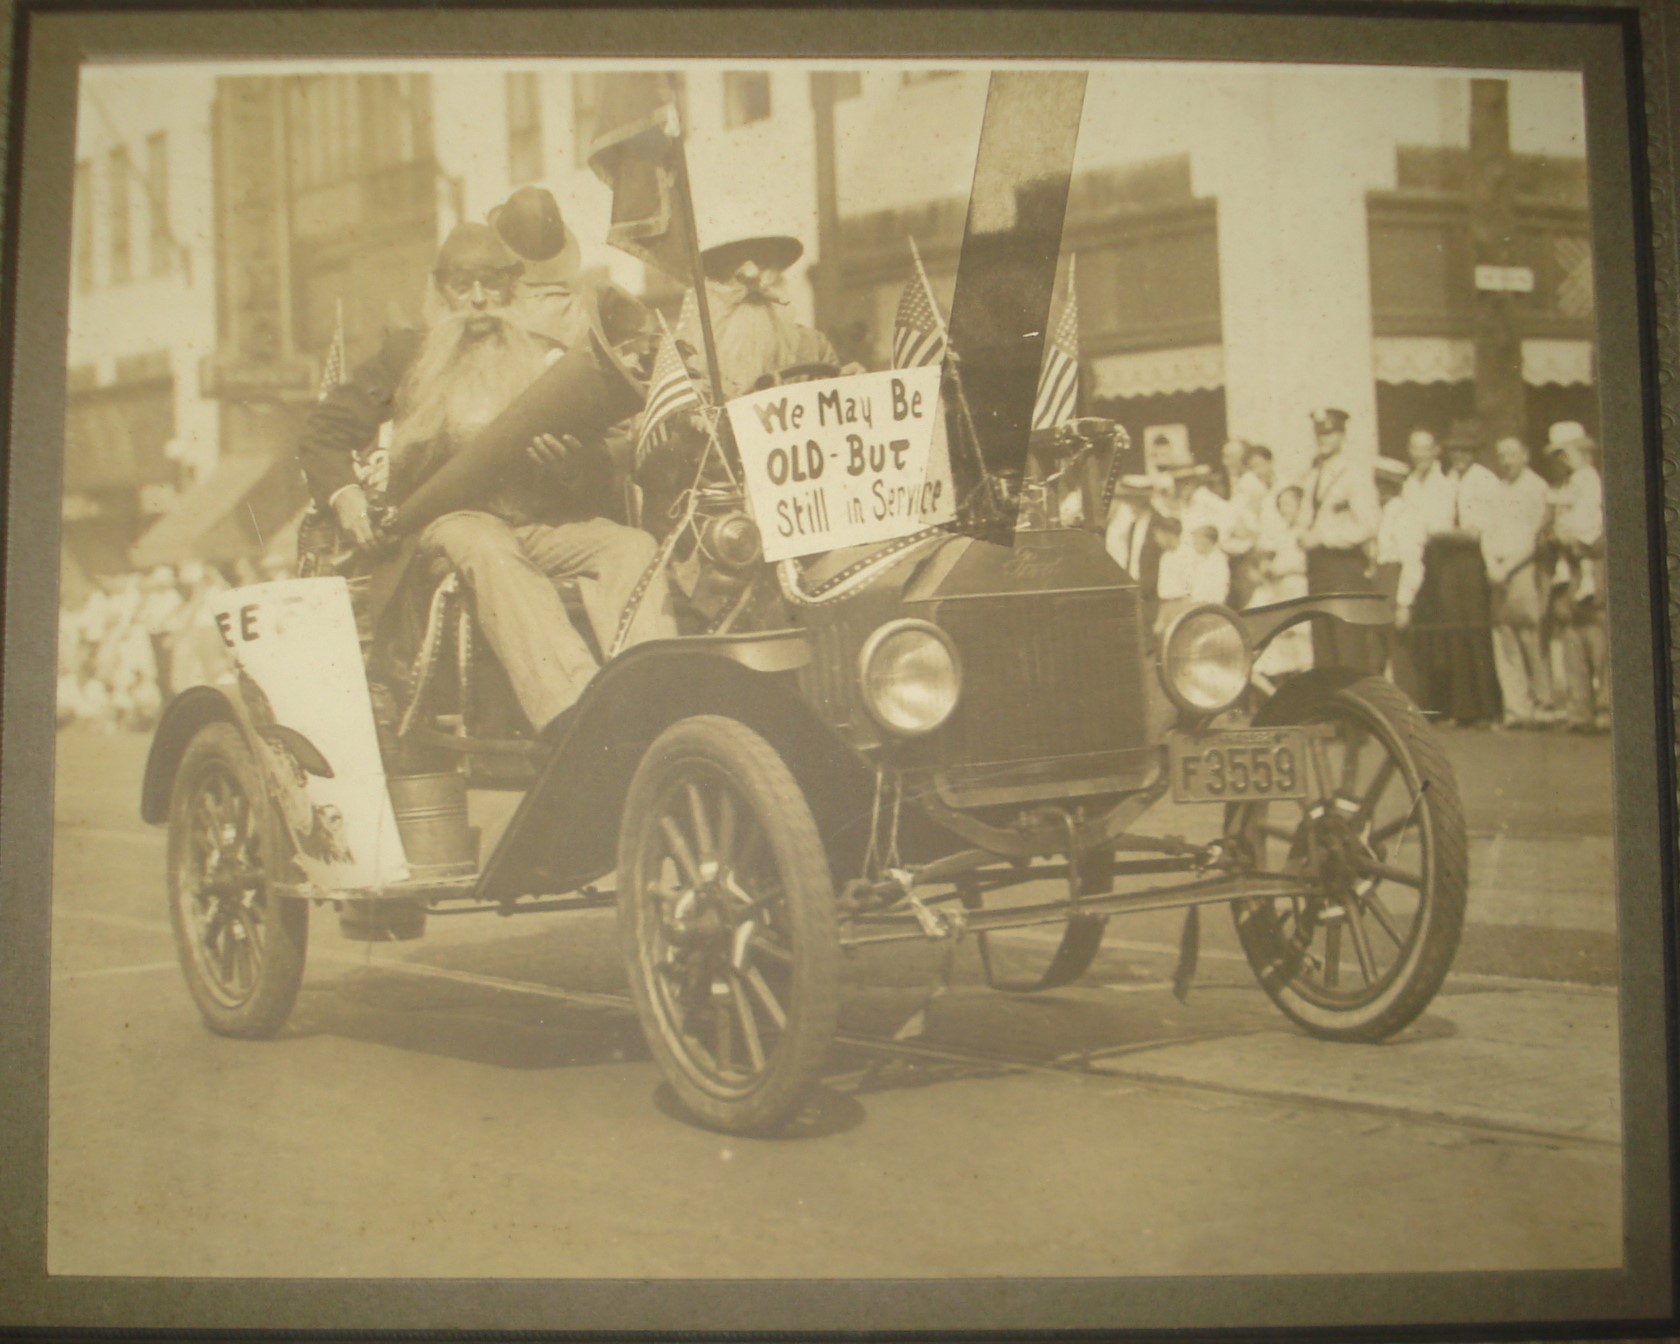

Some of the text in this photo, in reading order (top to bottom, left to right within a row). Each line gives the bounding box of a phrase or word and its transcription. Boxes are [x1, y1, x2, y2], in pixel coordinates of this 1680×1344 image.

[753, 378, 923, 434] We May Be
[777, 478, 942, 537] Still in Service
